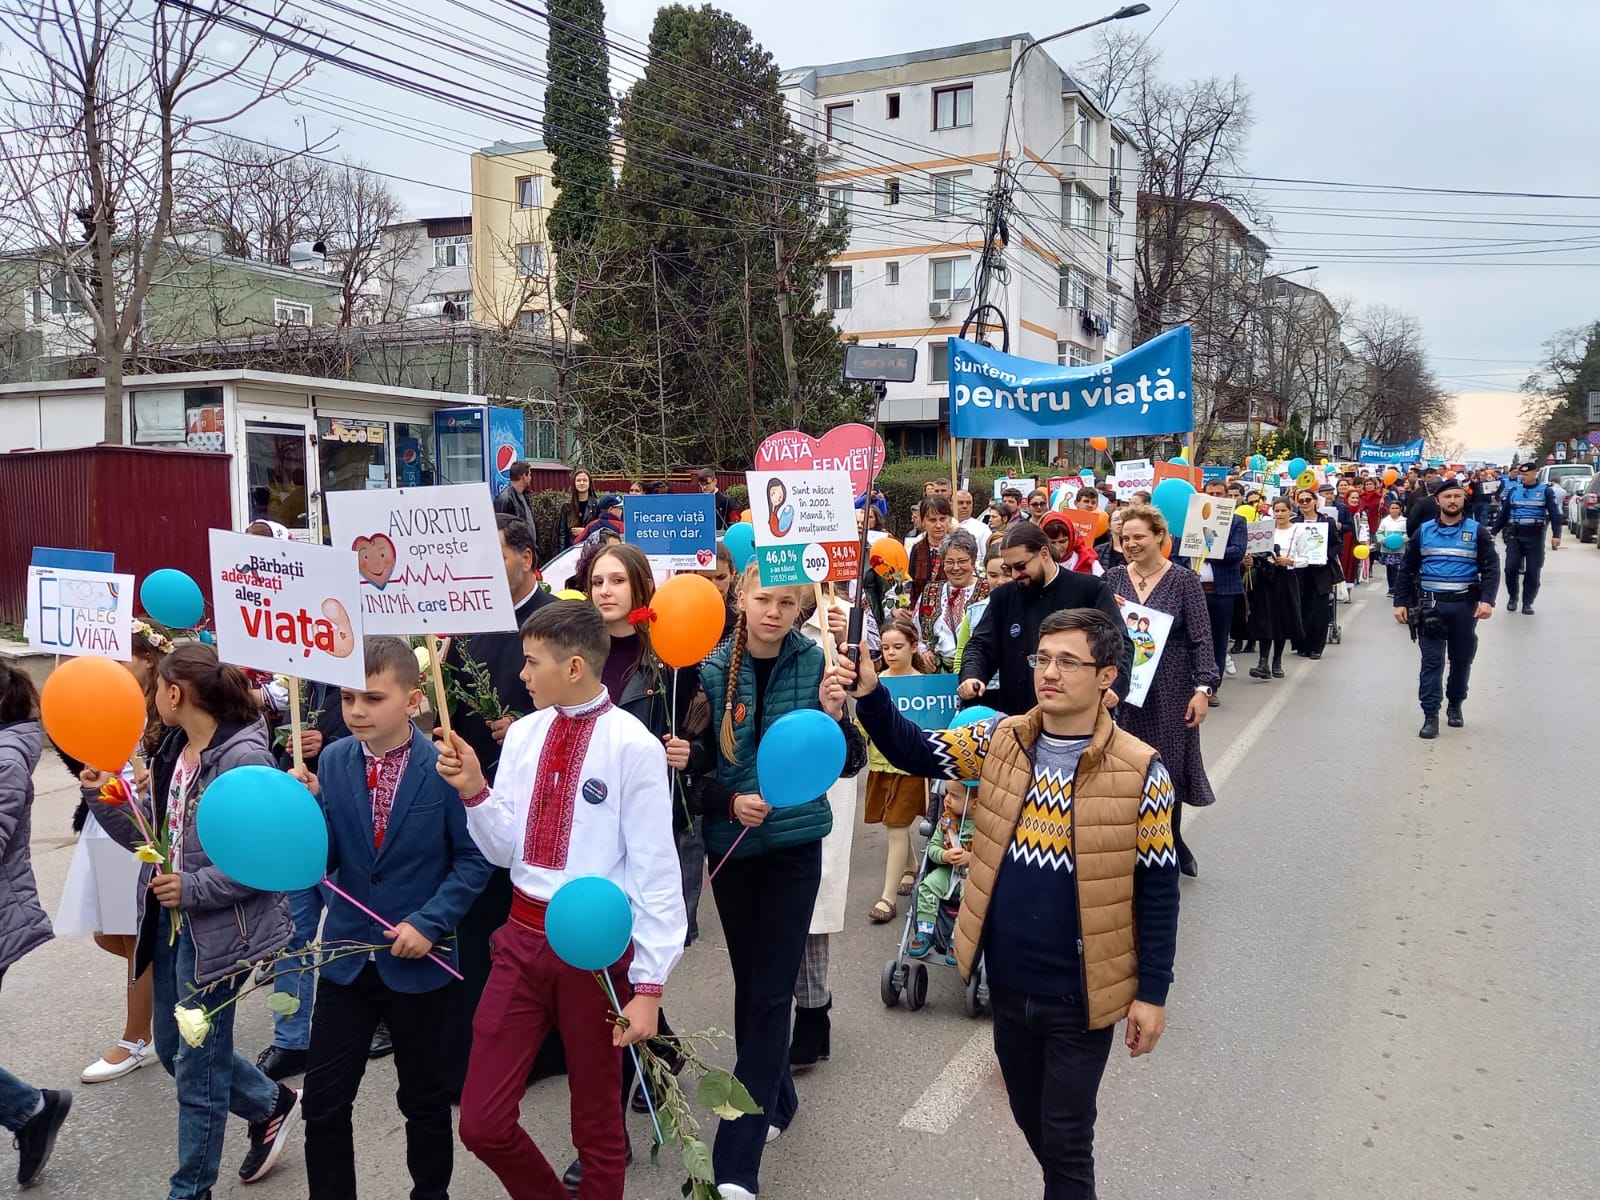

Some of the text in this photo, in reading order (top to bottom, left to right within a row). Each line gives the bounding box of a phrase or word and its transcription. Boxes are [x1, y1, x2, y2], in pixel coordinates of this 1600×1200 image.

[953, 356, 1017, 384] Suntem
[955, 384, 1070, 416] pentru
[1081, 367, 1187, 415] viață.
[761, 438, 813, 463] VIAȚĂ
[765, 437, 798, 449] pentru
[1361, 449, 1394, 459] pentru
[792, 485, 835, 495] Sunt născut
[799, 498, 807, 507] în
[389, 507, 481, 537] AVORTUL
[633, 510, 705, 525] Fiecare viață
[800, 510, 826, 521] Mamă,
[636, 526, 703, 538] este un dar.
[798, 523, 839, 536] mulțumesc!
[409, 537, 469, 561] oprește
[765, 550, 786, 565] 46,0
[831, 546, 848, 560] 54,0
[249, 556, 305, 581] Bărbații
[805, 557, 827, 568] 2002
[235, 586, 262, 607] aleg
[365, 589, 415, 614] INIMĂ
[417, 599, 447, 612] care
[448, 590, 494, 612] BATE
[39, 577, 75, 648] EU
[76, 608, 116, 625] ALEG
[240, 598, 335, 658] viața
[896, 693, 961, 714] DOPȚIE
